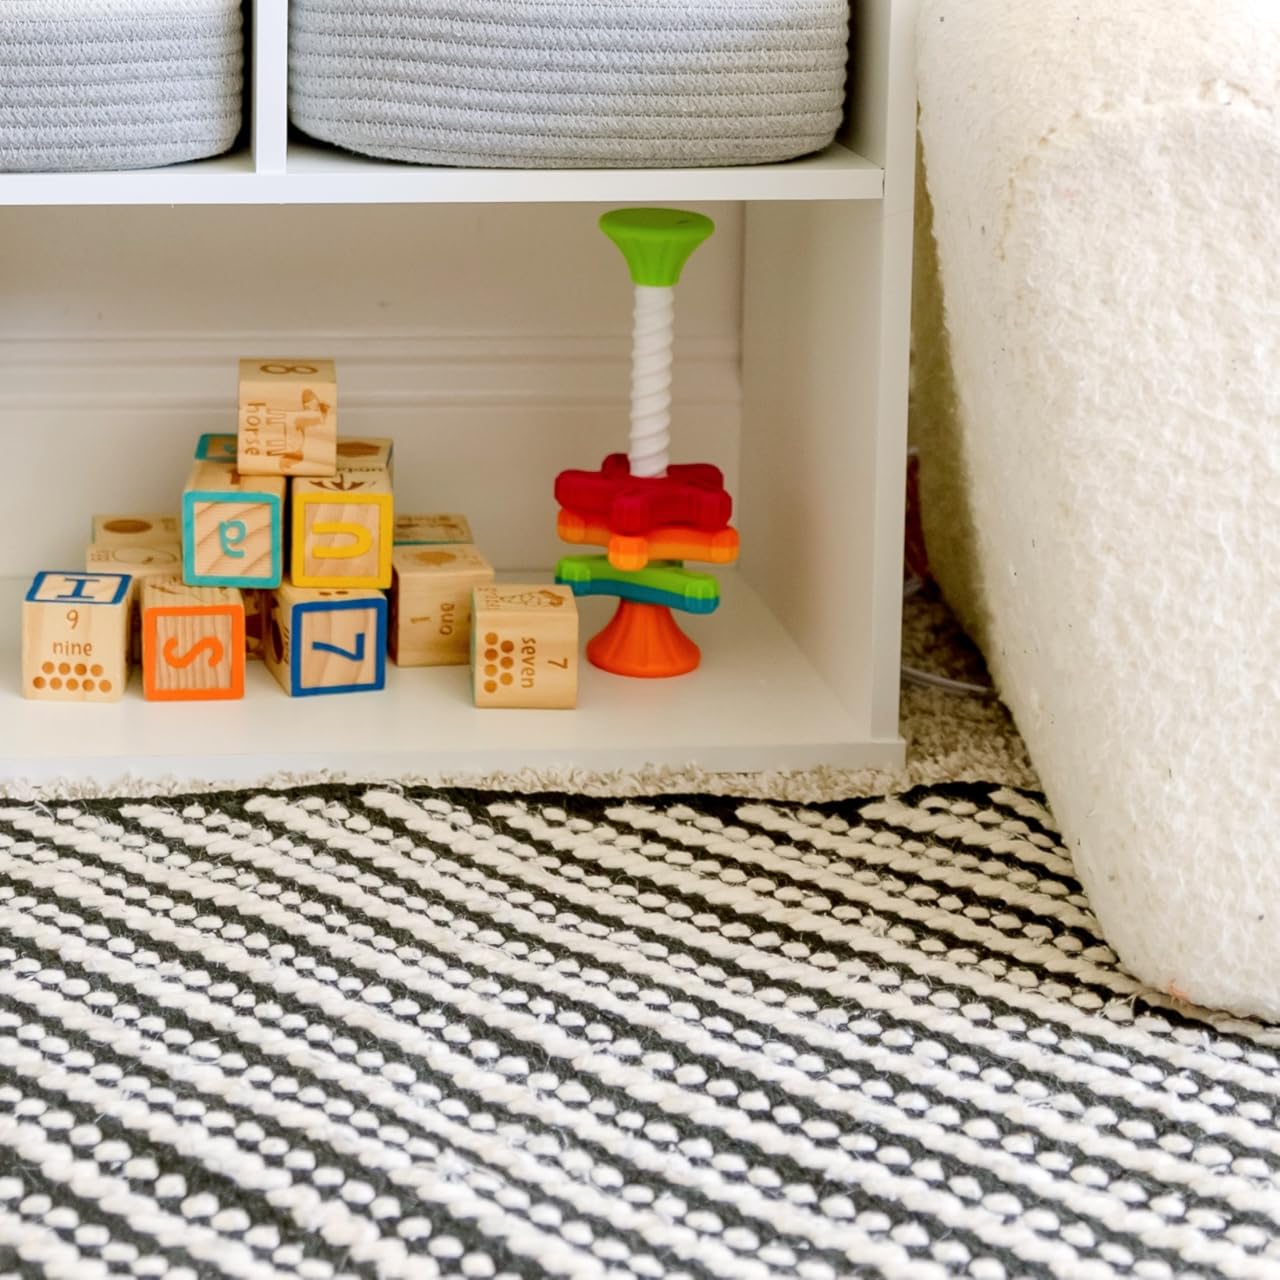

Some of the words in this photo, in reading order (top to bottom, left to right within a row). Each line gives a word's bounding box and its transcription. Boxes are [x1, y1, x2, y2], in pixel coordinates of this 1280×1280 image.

[244, 402, 267, 457] horse
[66, 609, 80, 630] 9
[438, 602, 455, 636] one
[52, 640, 93, 657] nine
[163, 635, 225, 670] S
[311, 631, 365, 662] 7
[520, 637, 537, 689] seven
[547, 657, 569, 670] 7
